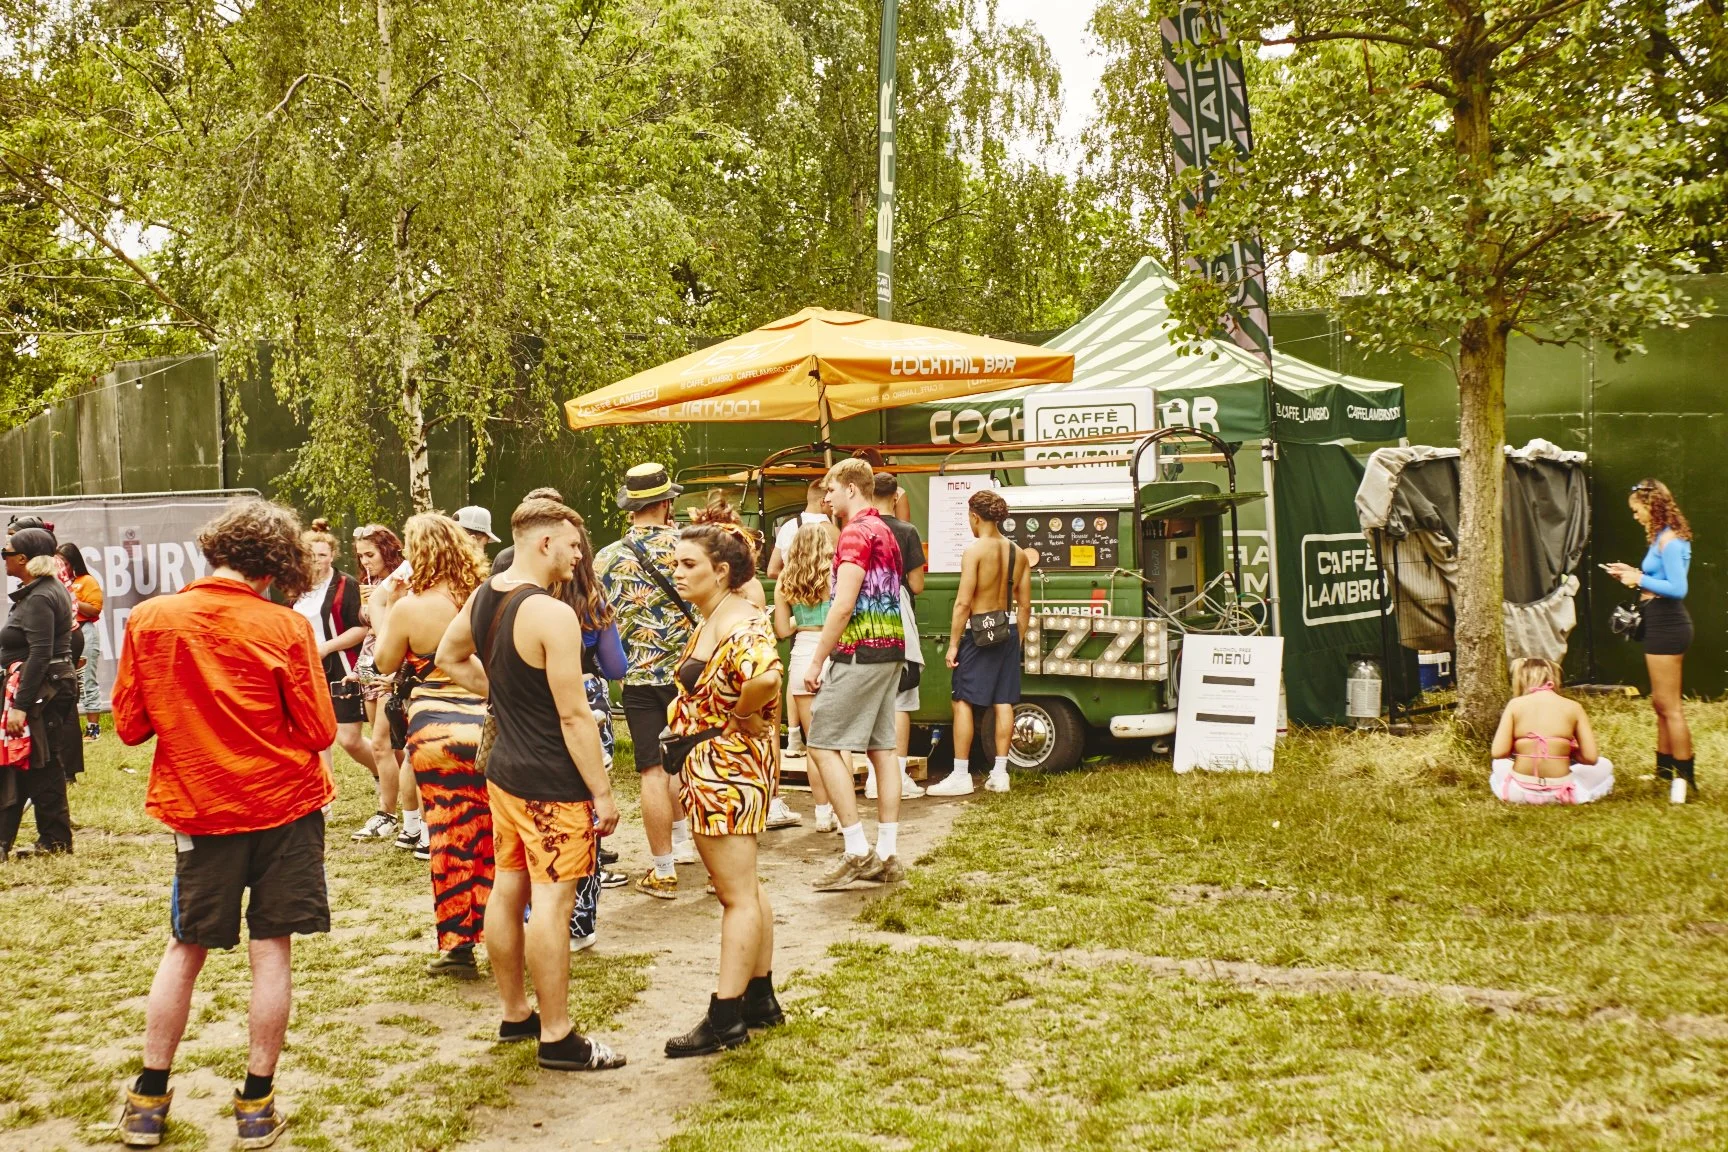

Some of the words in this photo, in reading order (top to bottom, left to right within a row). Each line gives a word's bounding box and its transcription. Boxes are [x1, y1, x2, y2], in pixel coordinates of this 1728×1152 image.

[890, 355, 979, 376] COCKTAIL
[983, 354, 1017, 374] BAR
[613, 389, 655, 406] LAMBRO
[1054, 409, 1118, 424] CAFFÈ
[1159, 396, 1220, 433] AR
[1043, 426, 1129, 439] LAMBRO
[947, 482, 971, 491] MENU
[1308, 578, 1389, 608] LAMBRO
[1030, 606, 1105, 617] LAMBRO
[1212, 653, 1252, 665] MENU
